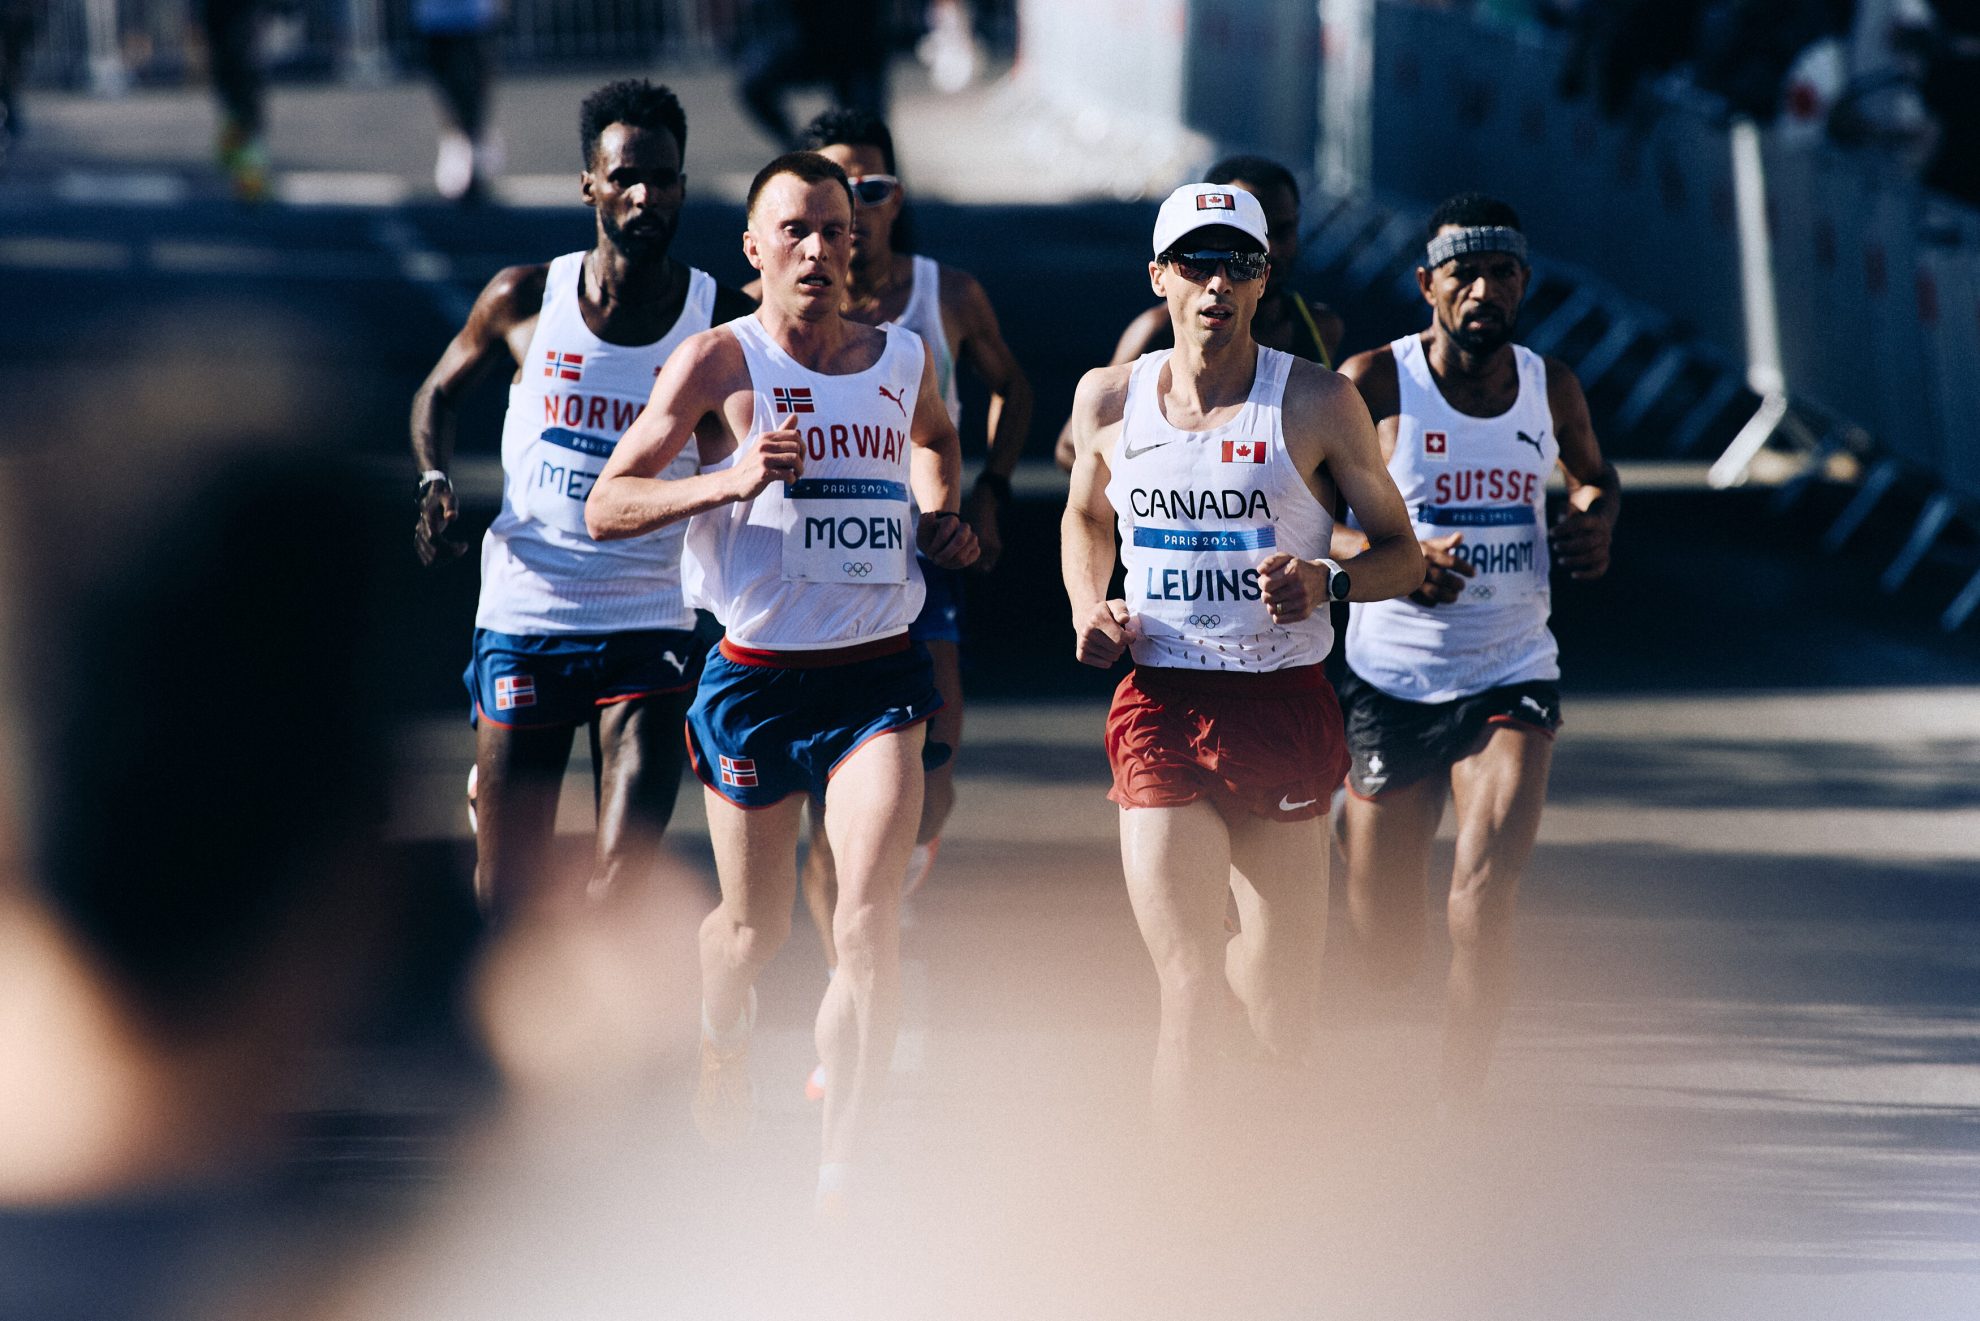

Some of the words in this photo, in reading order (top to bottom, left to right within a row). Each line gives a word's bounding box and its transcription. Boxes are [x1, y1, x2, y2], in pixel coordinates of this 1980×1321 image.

[544, 395, 648, 432] NORW
[797, 424, 905, 466] ORWAY
[861, 484, 889, 494] 2024
[1130, 488, 1271, 520] CANADA
[805, 517, 903, 550] MOEN
[1202, 536, 1236, 546] 2024
[1455, 542, 1533, 574] RAHAM
[1146, 567, 1262, 602] LEVINS
